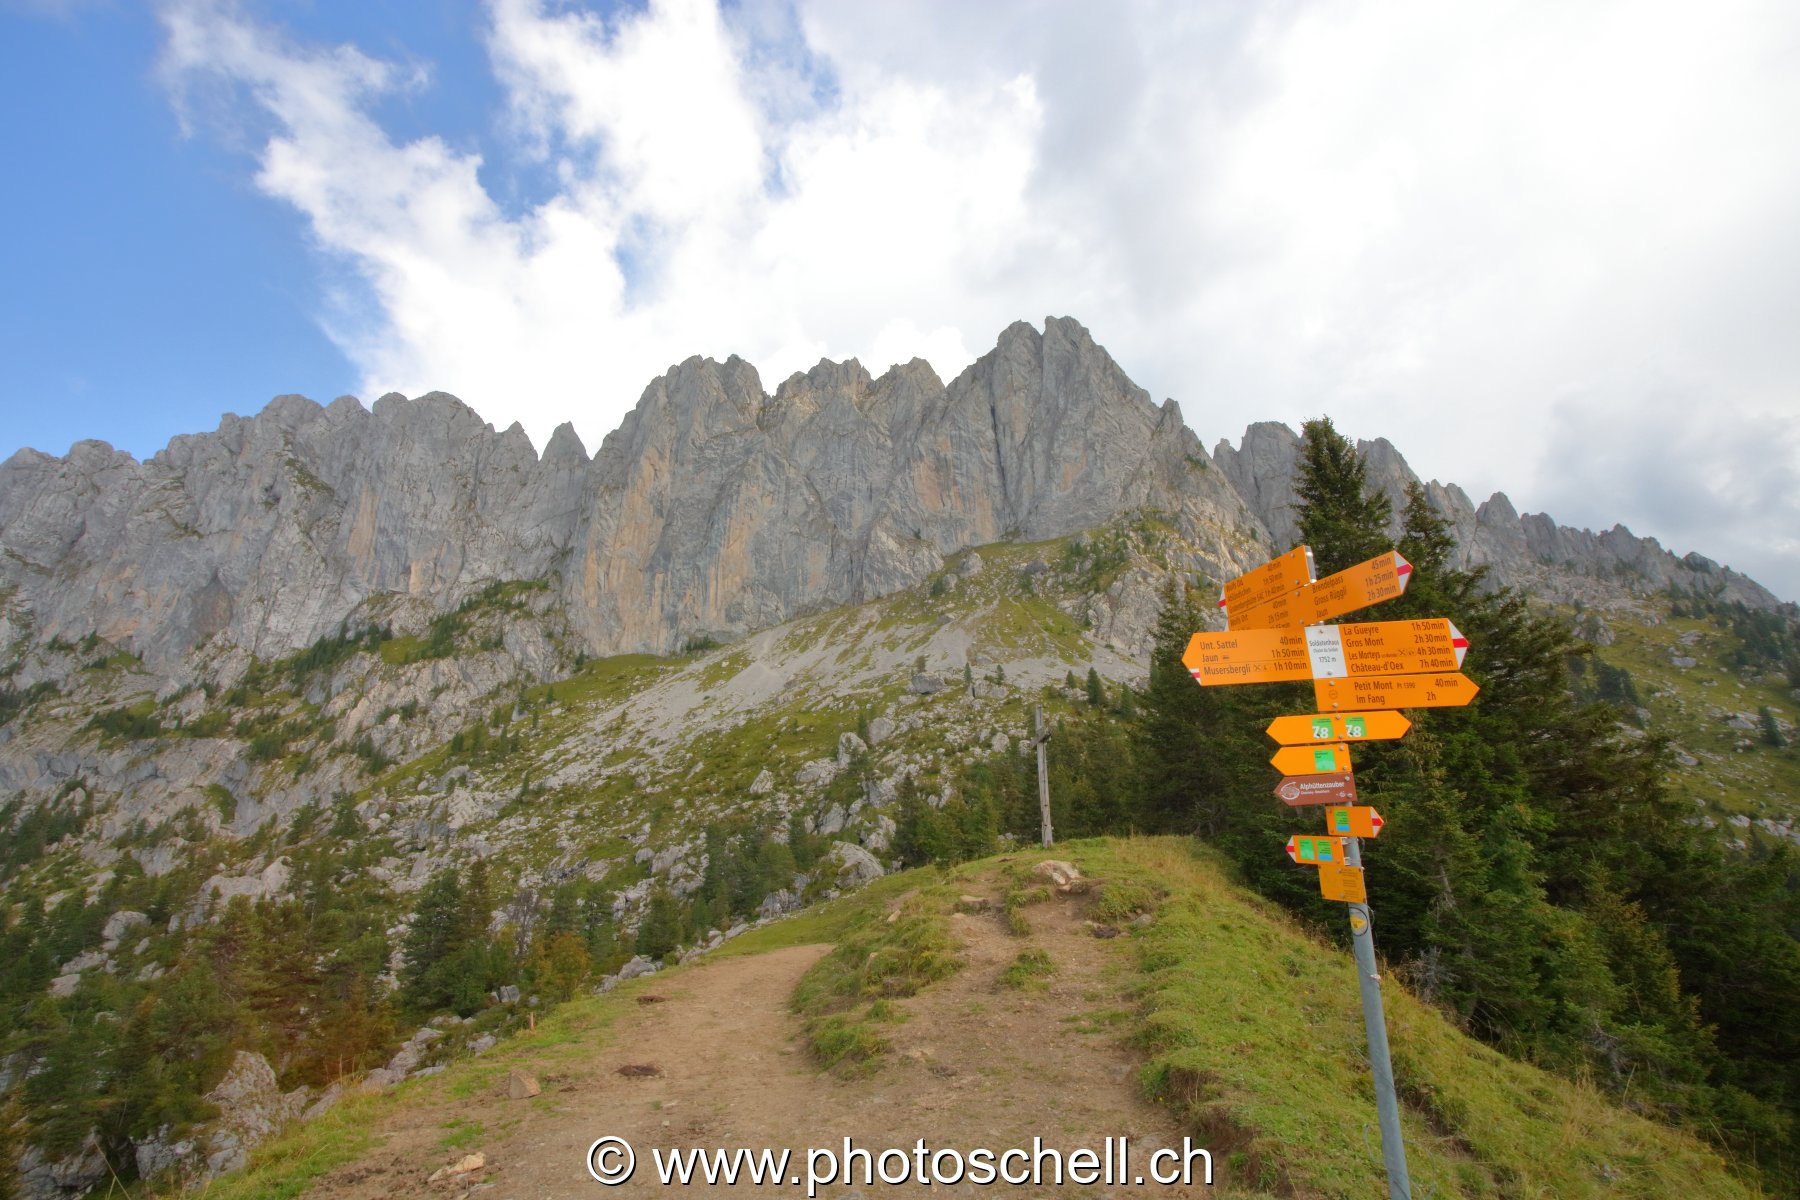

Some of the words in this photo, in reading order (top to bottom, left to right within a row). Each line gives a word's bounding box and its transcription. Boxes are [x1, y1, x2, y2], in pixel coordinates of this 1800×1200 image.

[1311, 576, 1344, 593] Brendelpass
[1371, 558, 1392, 570] 45min
[1313, 596, 1329, 606] Gross
[1343, 626, 1352, 636] La
[1353, 625, 1380, 637] Gueyre
[1200, 641, 1215, 650] Unt.
[1216, 639, 1238, 650] Sattel
[1280, 636, 1302, 645] 40min
[1345, 638, 1363, 648] Gros
[1364, 637, 1384, 647] Mont
[1202, 654, 1218, 663] Jaun
[1348, 651, 1358, 661] Les
[1358, 650, 1381, 662] Morteys
[1203, 663, 1251, 676] Musersbergli
[1350, 660, 1404, 673] Château-d'Oex
[1353, 681, 1371, 691] Petit
[1373, 680, 1393, 690] Mont
[1434, 677, 1458, 688] 40min
[1356, 694, 1366, 704] Im
[1367, 693, 1386, 705] Fang
[1426, 691, 1437, 701] 2h
[1312, 725, 1329, 739] 78
[1345, 724, 1362, 738] 78
